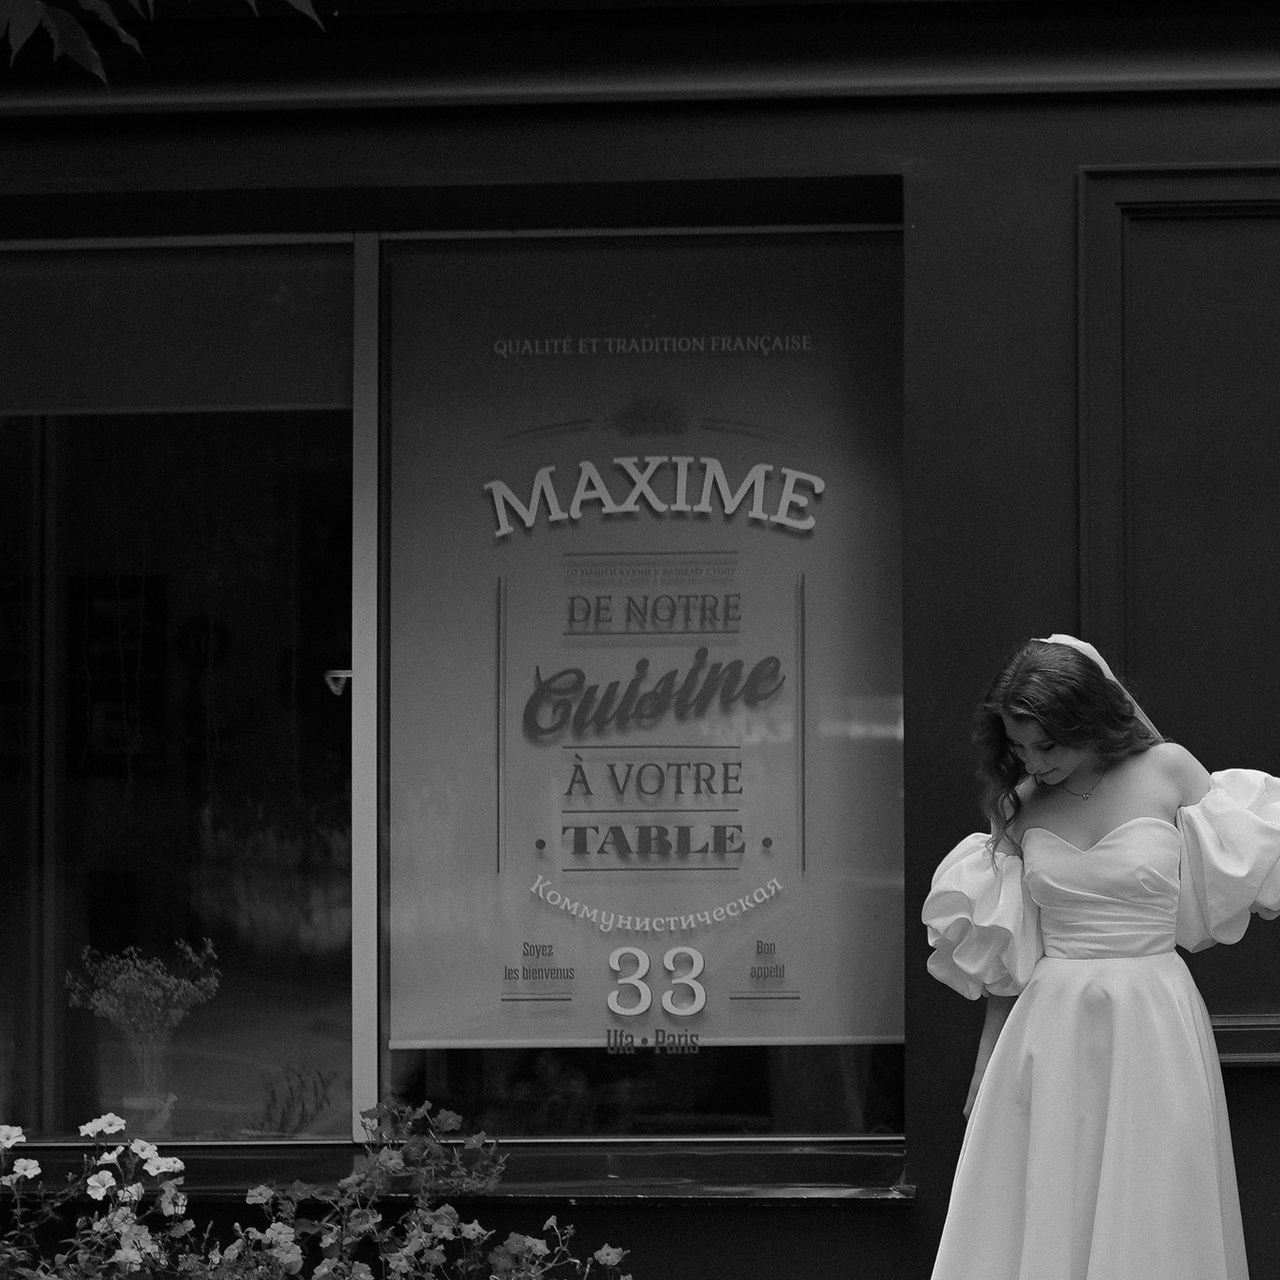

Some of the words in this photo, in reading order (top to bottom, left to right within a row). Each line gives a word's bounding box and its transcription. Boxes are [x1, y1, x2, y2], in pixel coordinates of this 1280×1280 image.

[493, 334, 572, 358] QUALITÉ
[578, 337, 600, 355] ET
[605, 336, 705, 354] TRADITION
[711, 334, 812, 356] FRANÇAISE
[484, 456, 826, 538] MAXIME
[568, 595, 613, 624] DE
[625, 593, 742, 623] NOTRE
[523, 647, 786, 736] Cuisine
[564, 754, 593, 796] À
[607, 762, 743, 796] VOTRE
[562, 824, 746, 856] TABLE
[529, 873, 785, 933] Коммунистическая
[523, 941, 554, 959] Soyez
[756, 940, 776, 955] Bon
[504, 965, 520, 981] les
[522, 965, 575, 981] bienvenus
[607, 946, 707, 1017] 33
[606, 1028, 635, 1055] Ufa
[654, 1028, 700, 1055] Paris
